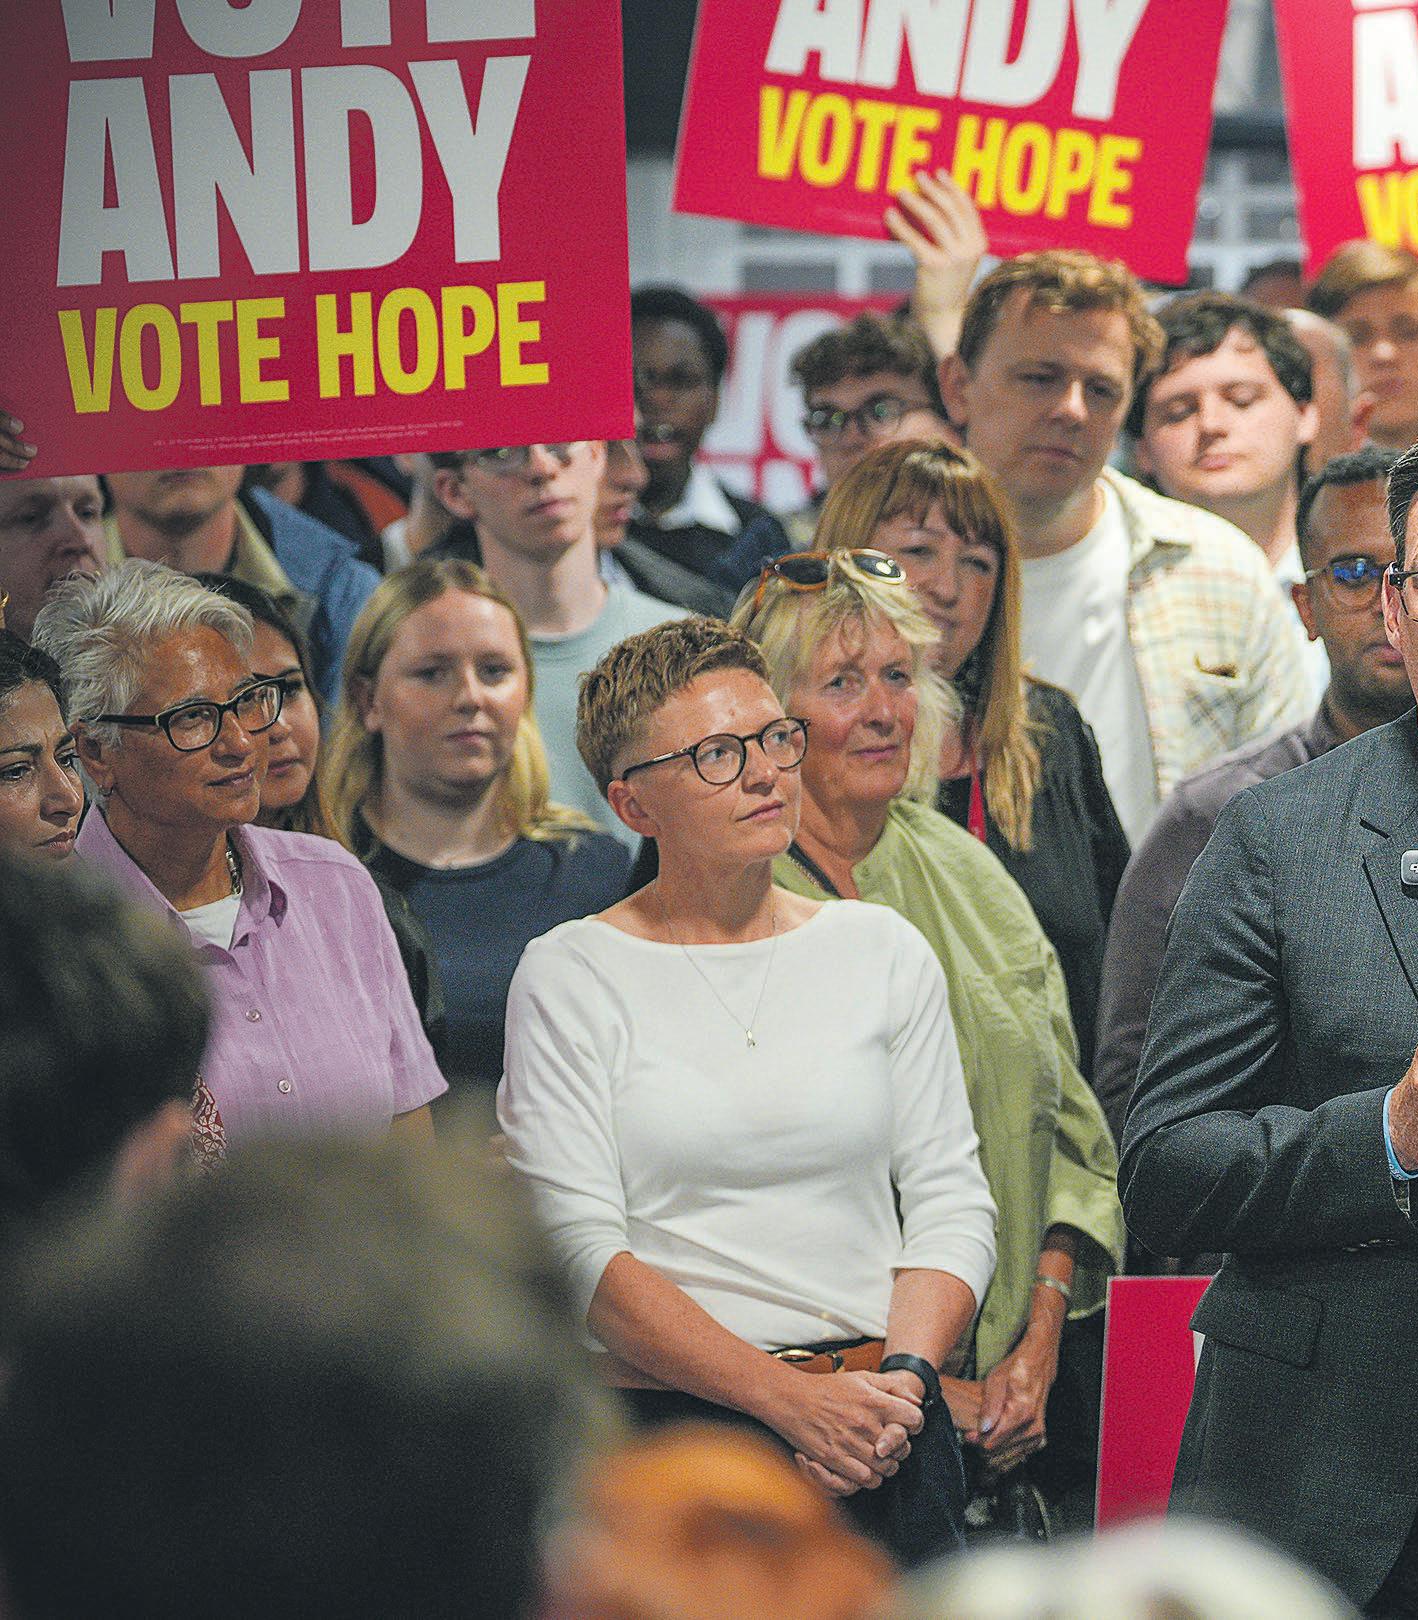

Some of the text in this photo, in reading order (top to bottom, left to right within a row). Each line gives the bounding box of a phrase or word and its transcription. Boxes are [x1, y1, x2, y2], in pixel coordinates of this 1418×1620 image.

[57, 55, 531, 287] ANDY
[757, 84, 1142, 229] VOTE HOPE
[57, 281, 549, 413] VOTE HOPE
